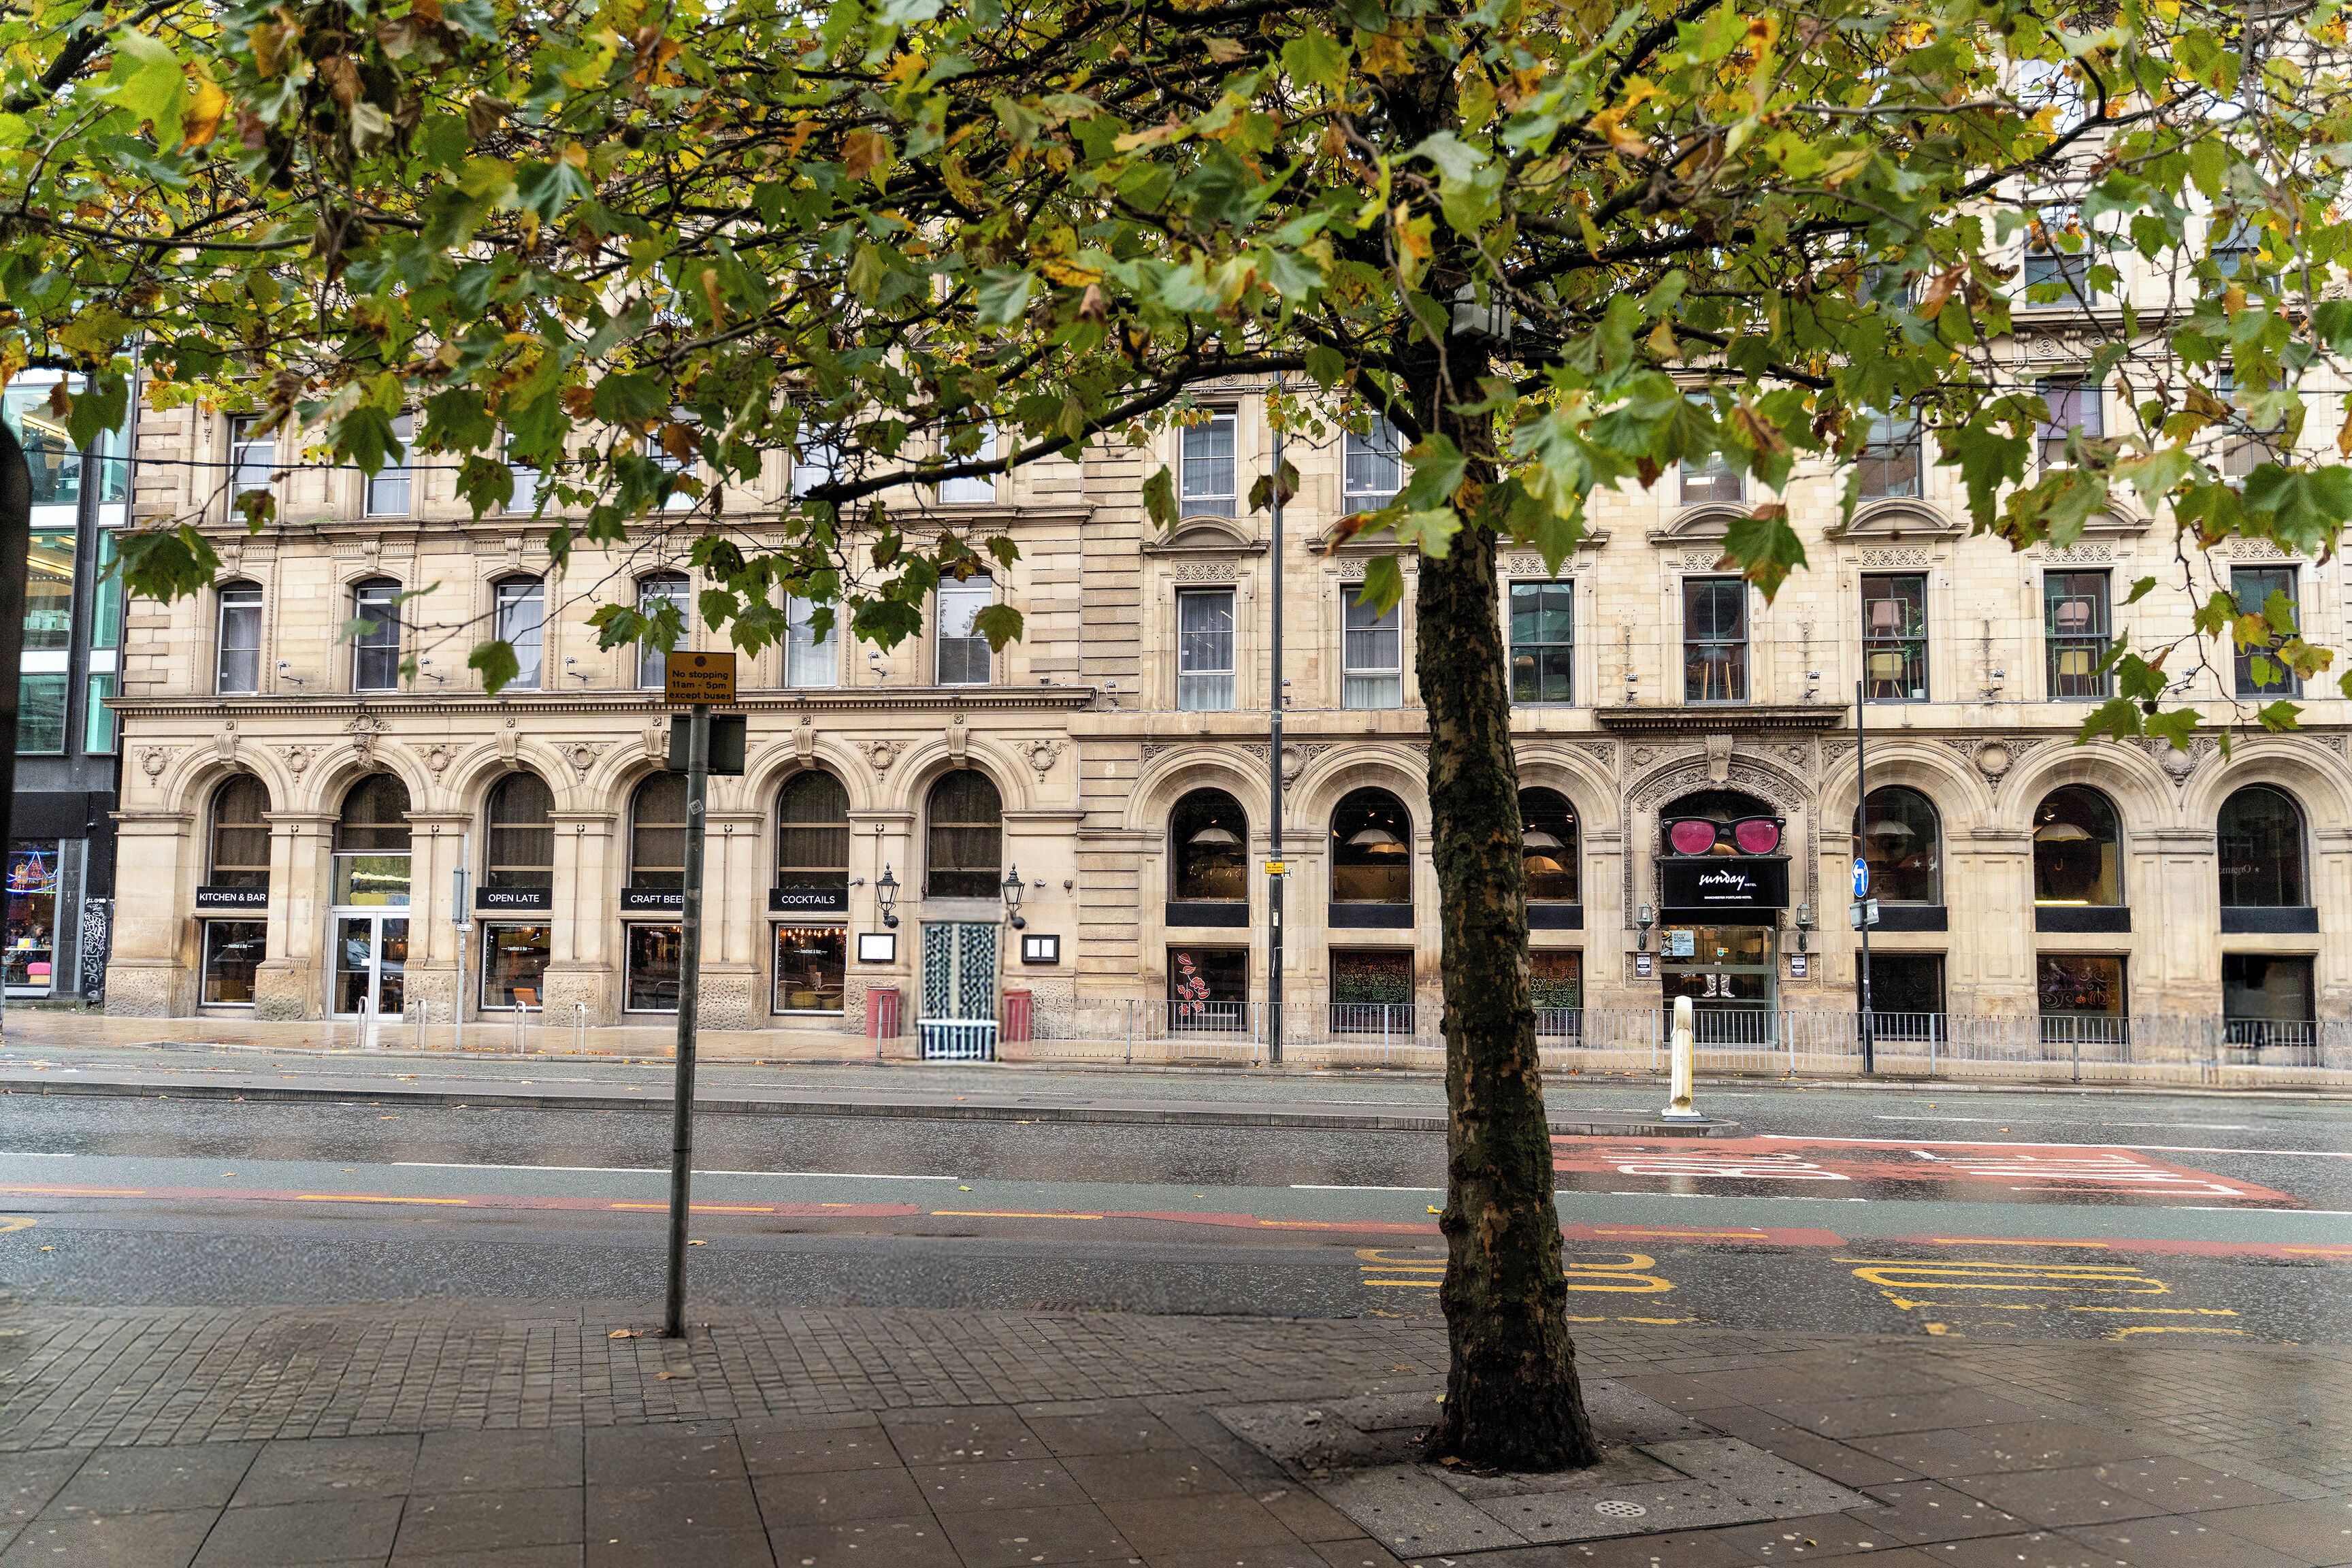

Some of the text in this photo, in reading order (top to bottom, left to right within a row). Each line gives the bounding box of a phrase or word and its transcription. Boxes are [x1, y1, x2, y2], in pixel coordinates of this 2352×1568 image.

[672, 670, 728, 681] No stopping
[706, 681, 726, 690] 5pm
[1699, 870, 1746, 891] sunday
[199, 893, 267, 902] KITCHEN & BAR
[488, 894, 540, 902] OPEN LATE
[630, 895, 662, 903] CRAFT
[781, 895, 836, 904] COCKTAILS
[1589, 1146, 1851, 1179] BUS
[1909, 1150, 2247, 1196] LANE
